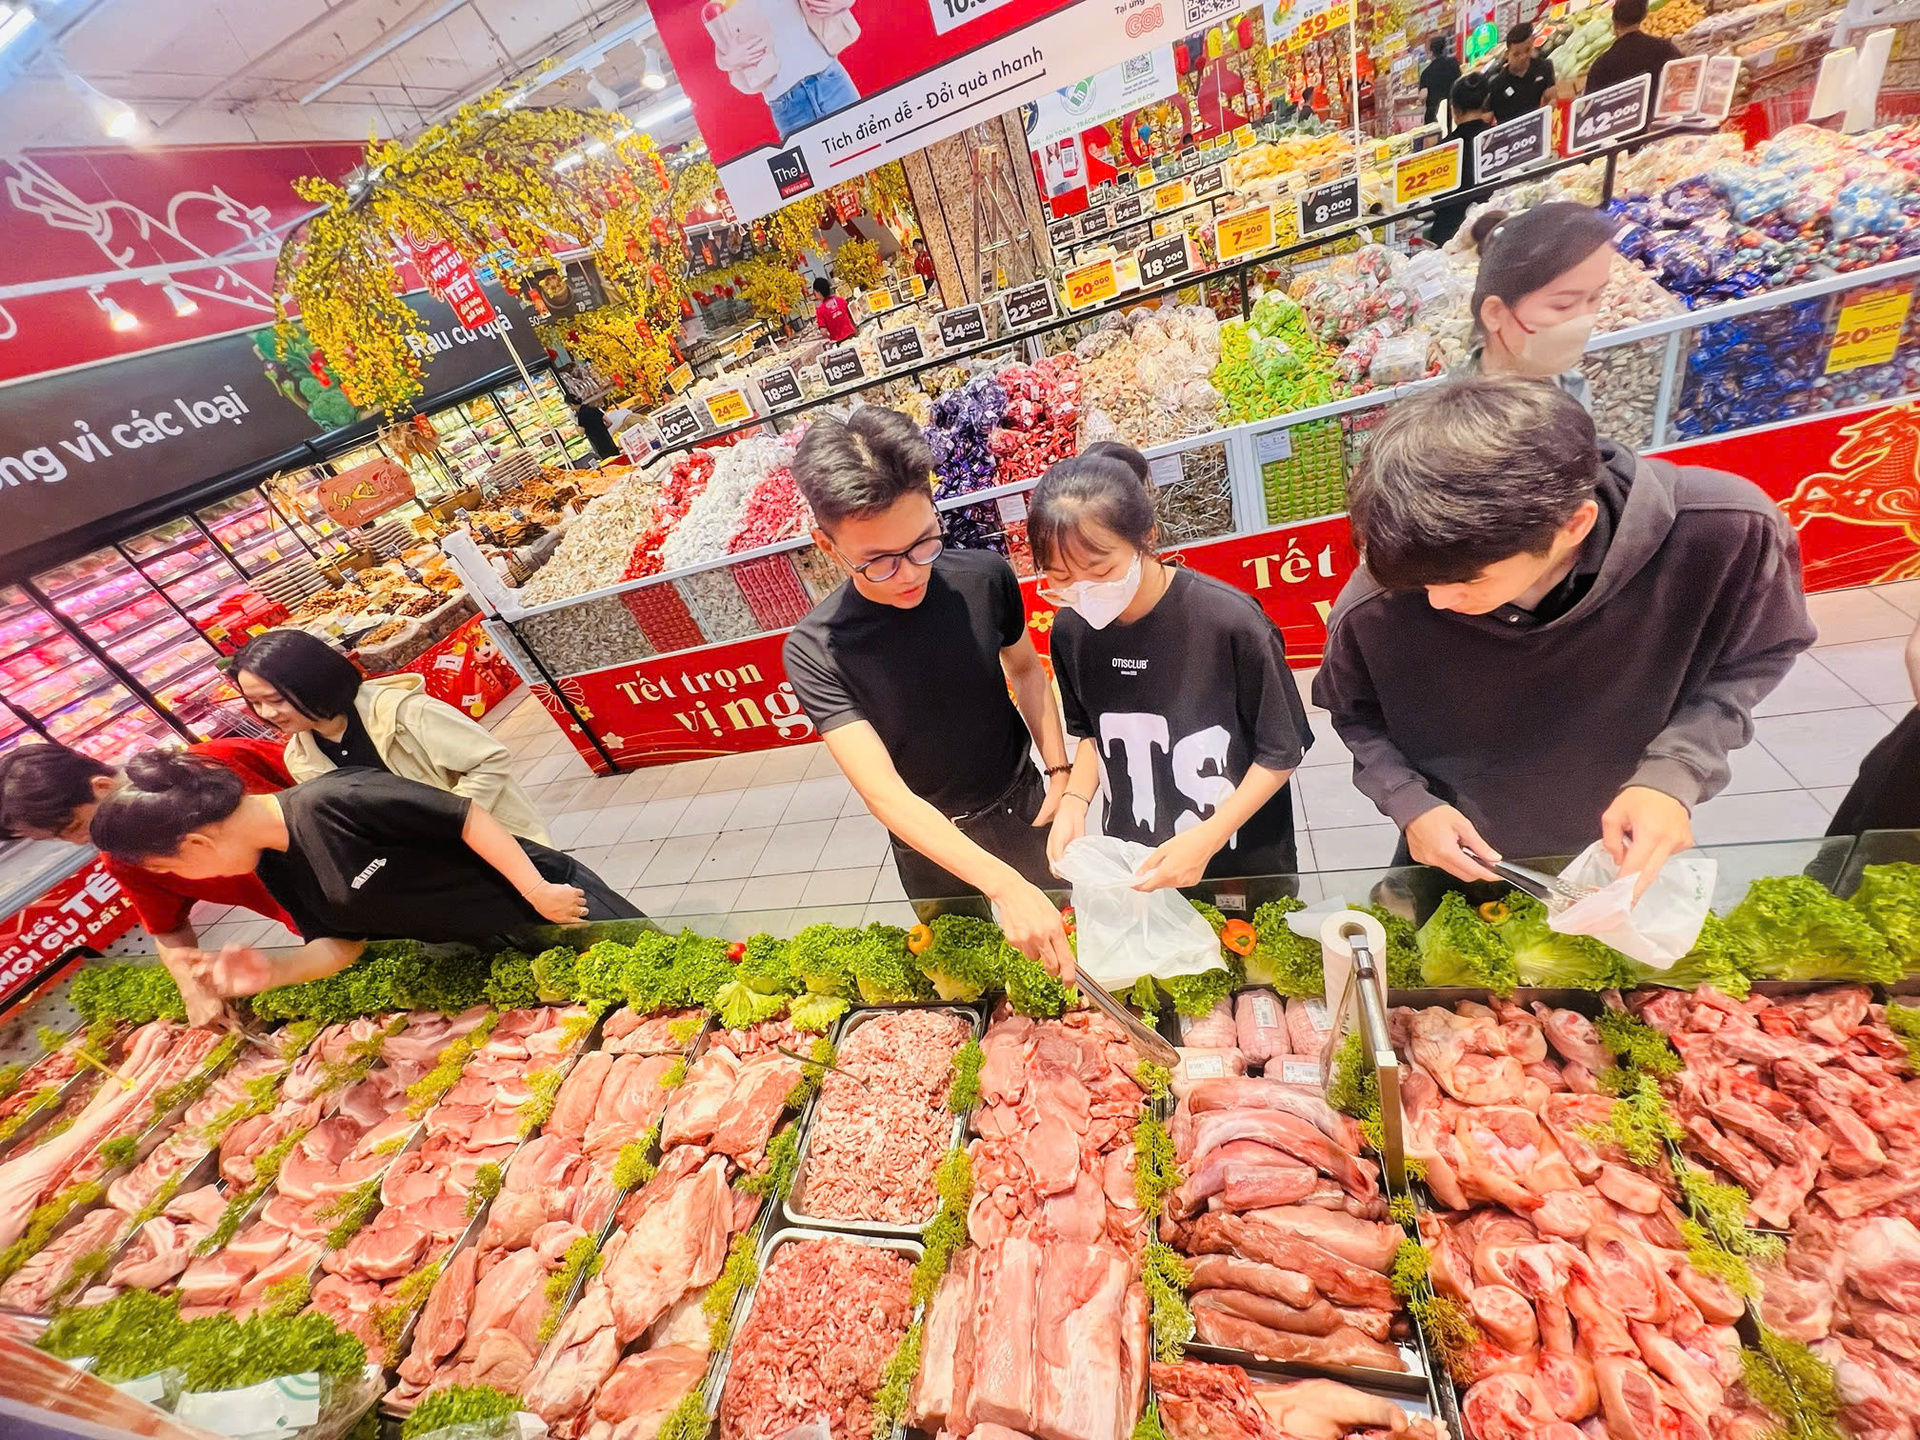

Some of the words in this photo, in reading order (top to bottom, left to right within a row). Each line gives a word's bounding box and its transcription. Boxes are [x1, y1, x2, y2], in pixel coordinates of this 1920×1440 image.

[822, 131, 852, 155] Tích
[856, 114, 892, 142] điểm
[894, 99, 914, 124] dễ
[926, 81, 955, 110] Đổi
[957, 70, 989, 99] quà
[992, 47, 1044, 80] nhanh
[1576, 101, 1640, 138] 42.000
[1480, 134, 1537, 174] 25.000
[773, 167, 798, 183] The
[1315, 197, 1352, 223] 8.000
[430, 263, 450, 282] MỌI
[447, 250, 463, 269] GU
[1142, 250, 1184, 279] 18.000
[444, 270, 475, 304] TẾT
[1073, 275, 1110, 299] 20.000
[1008, 297, 1048, 323] 22.000
[943, 320, 981, 342] 34.000
[881, 340, 918, 363] 14.000
[825, 361, 856, 381] 18.000
[763, 383, 793, 403] 18.000
[0, 445, 68, 491] ng
[58, 419, 113, 464] vỉ
[111, 409, 184, 449] các
[173, 384, 250, 429] loại
[661, 416, 693, 440] 20.000
[1242, 537, 1337, 590] Tết
[1111, 657, 1148, 670] OTISCLUB
[615, 669, 677, 705] Tết
[677, 662, 765, 694] trọn
[58, 861, 122, 918] TẾ
[18, 915, 59, 946] kết
[40, 916, 80, 950] GU
